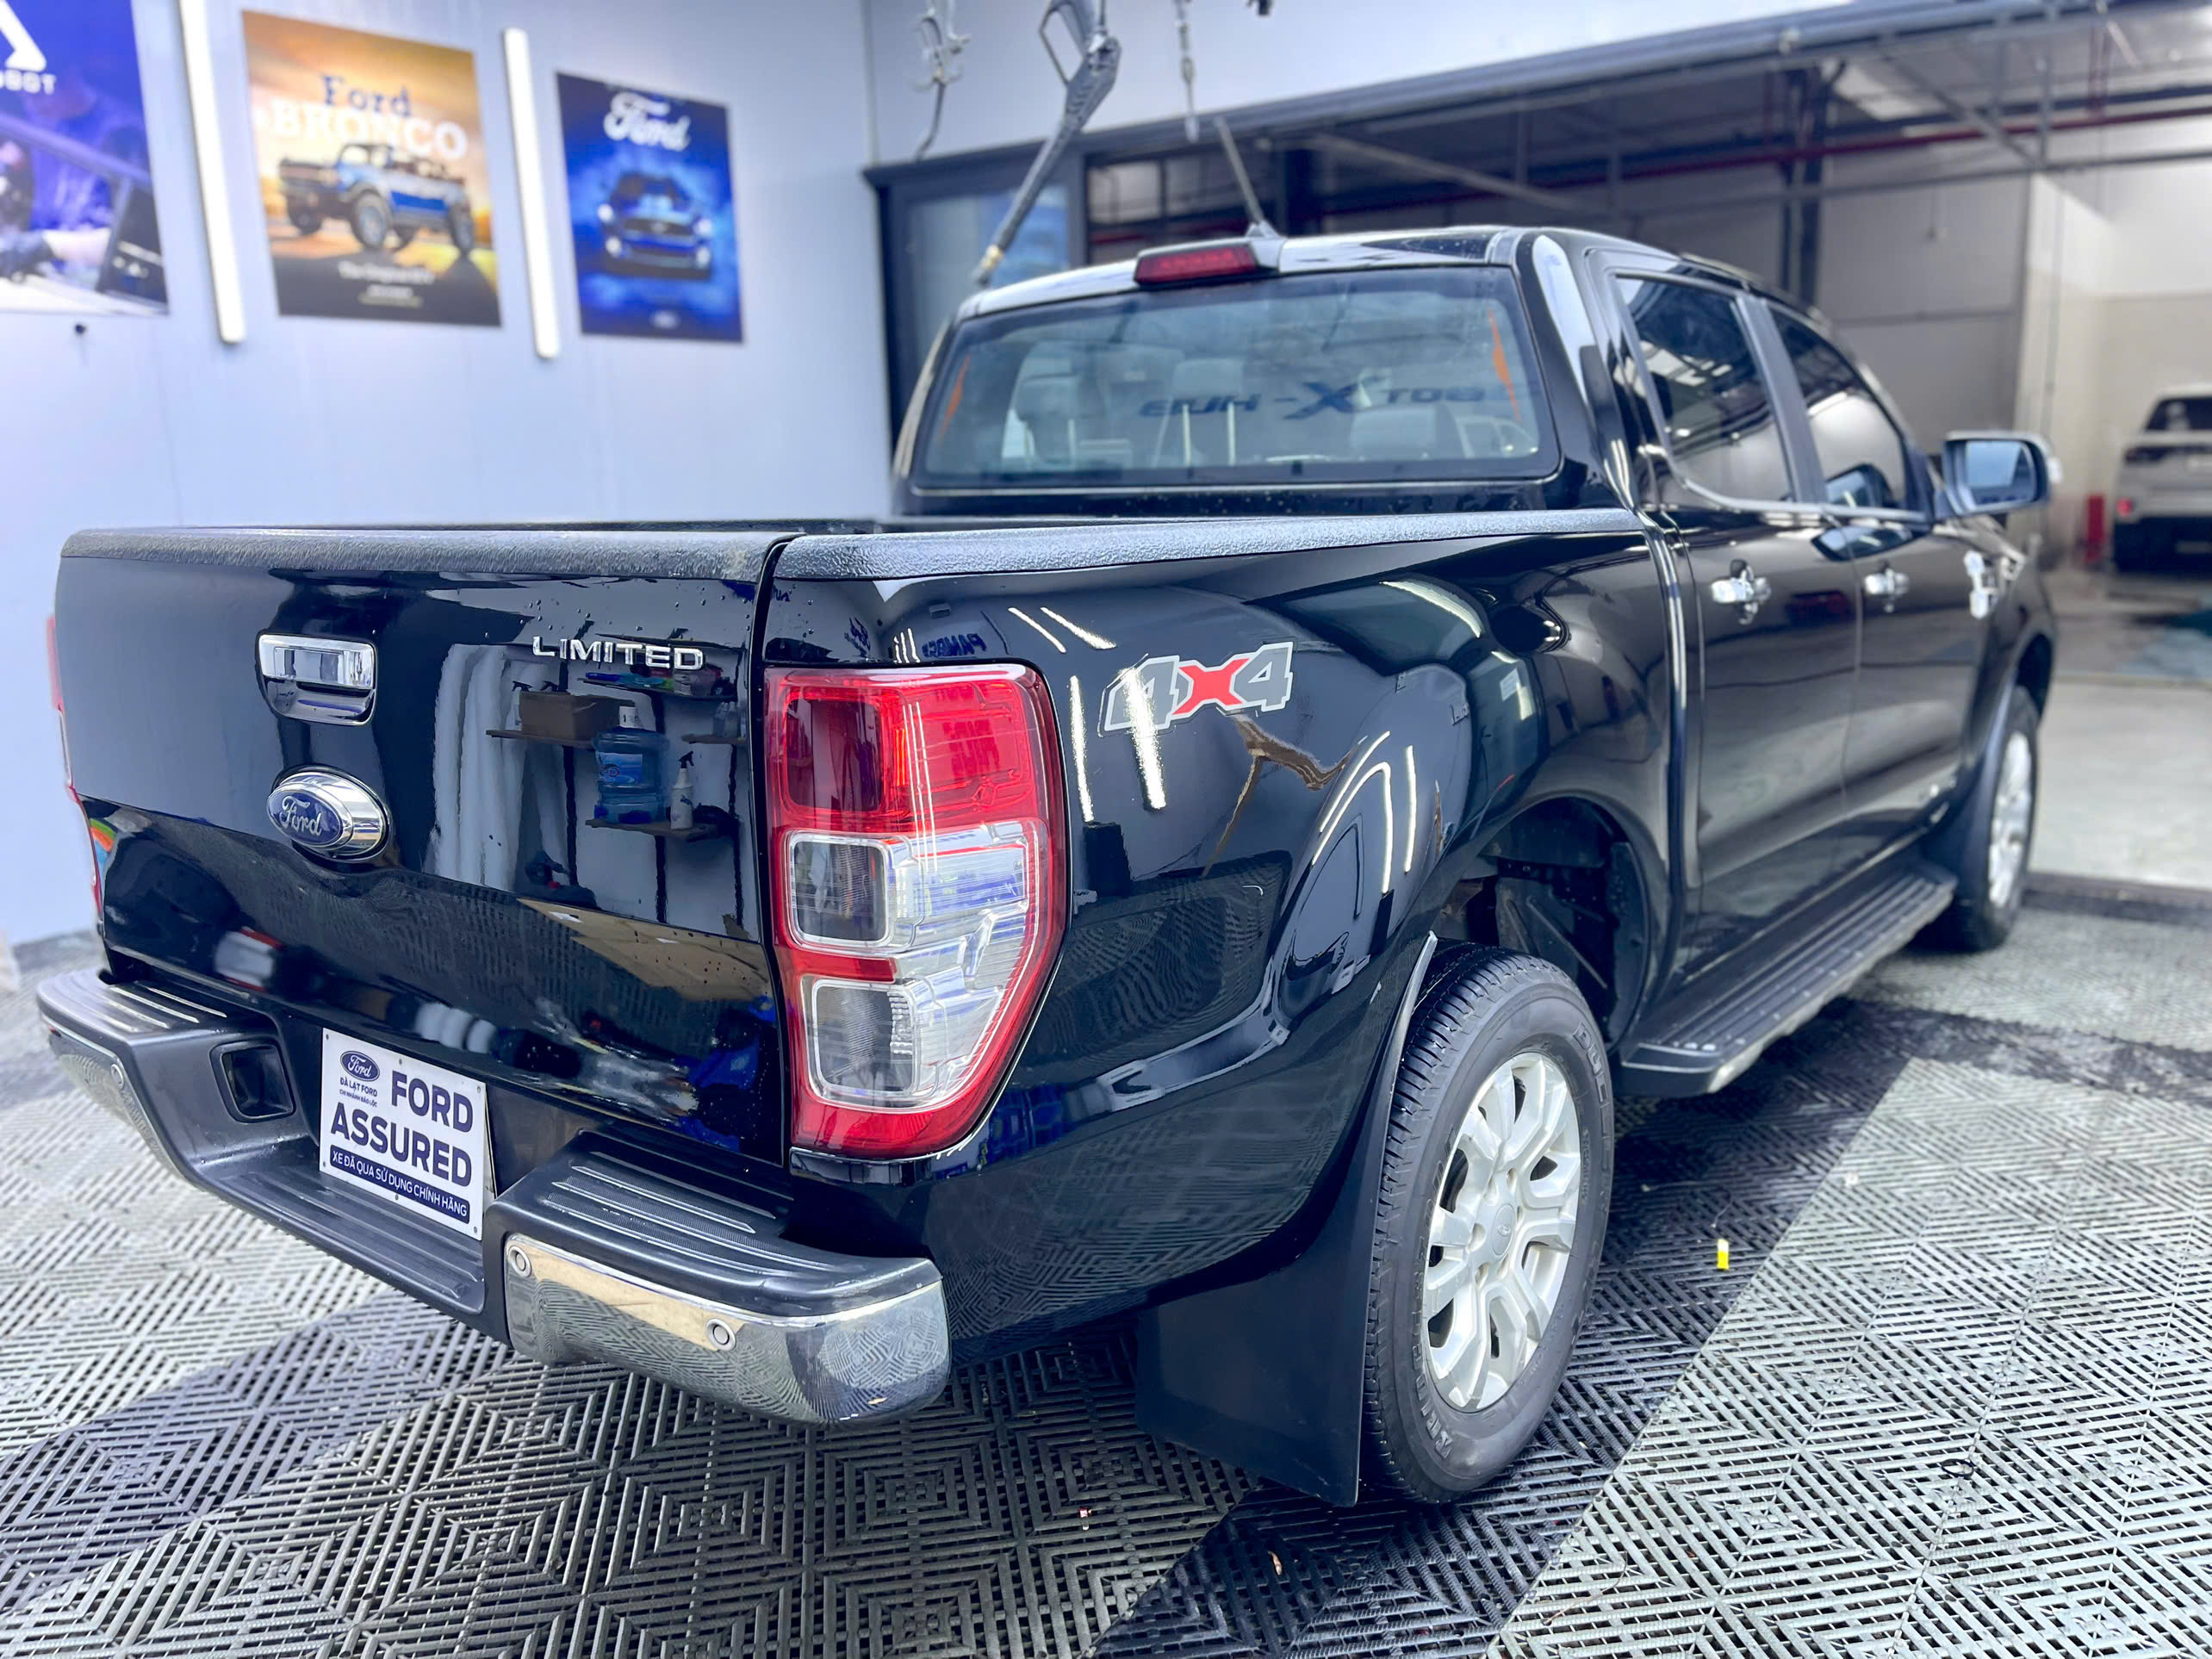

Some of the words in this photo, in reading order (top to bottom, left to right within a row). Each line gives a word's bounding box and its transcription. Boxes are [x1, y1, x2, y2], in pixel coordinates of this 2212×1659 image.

[323, 74, 412, 118] Ford
[532, 636, 705, 671] LIMITED
[281, 795, 323, 837] Ford
[348, 1053, 372, 1078] Ford
[349, 1080, 361, 1092] LẠT
[361, 1084, 378, 1097] FORD
[391, 1070, 473, 1133] FORD
[331, 1102, 472, 1187] ASSURED
[332, 1150, 344, 1165] XE
[344, 1155, 356, 1169] ĐÃ
[357, 1161, 375, 1177] QUA
[376, 1166, 388, 1183] SỬ
[388, 1173, 413, 1193] DỤNG
[413, 1184, 441, 1206] CHÍNH
[441, 1195, 468, 1217] HÃNG
